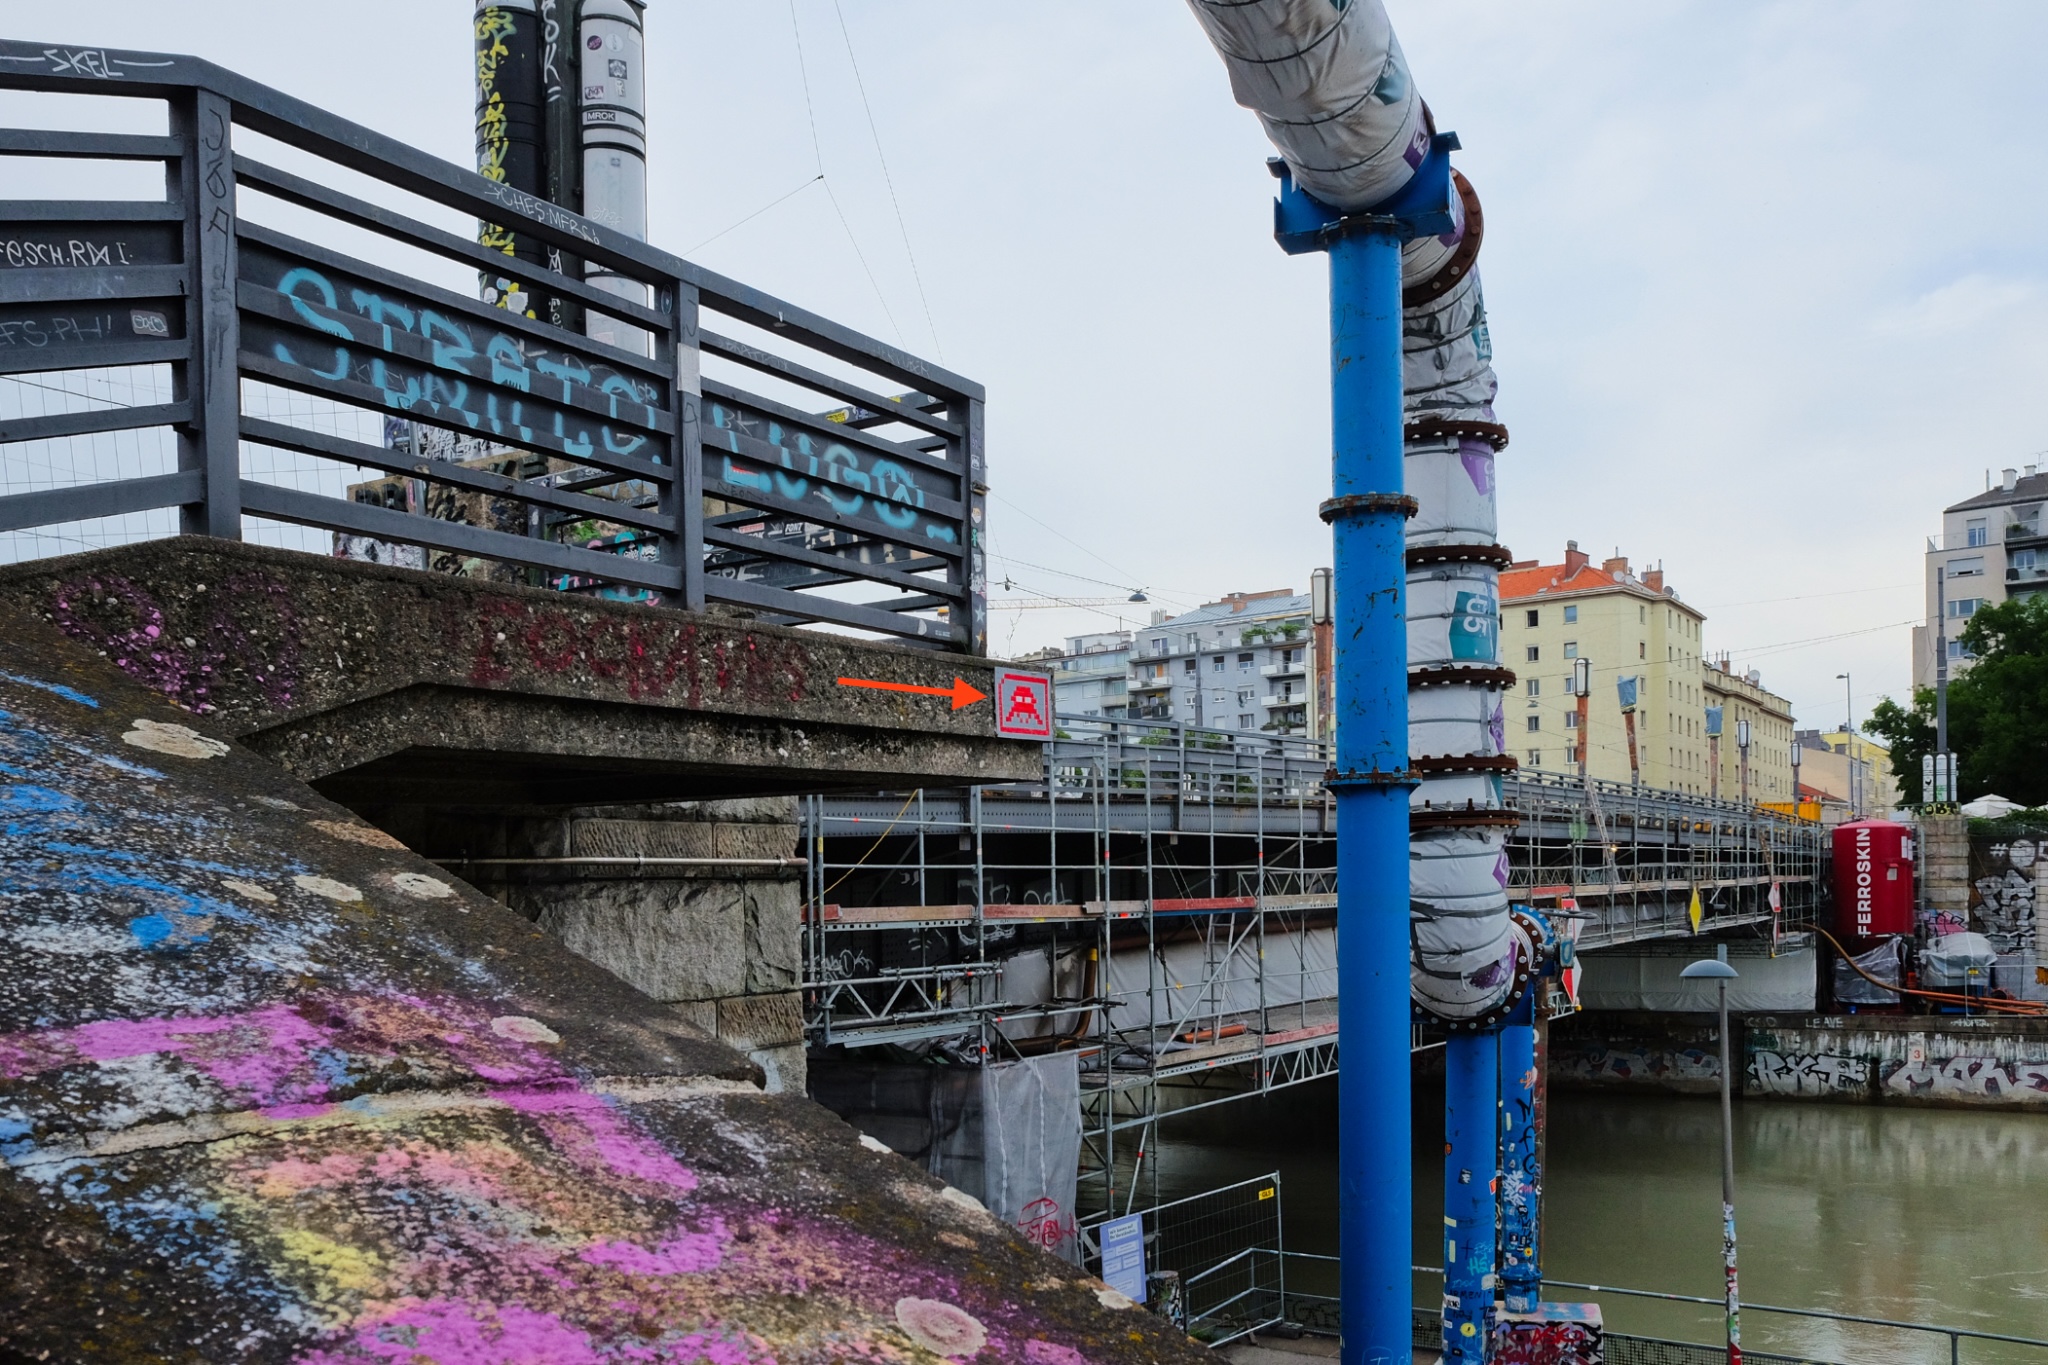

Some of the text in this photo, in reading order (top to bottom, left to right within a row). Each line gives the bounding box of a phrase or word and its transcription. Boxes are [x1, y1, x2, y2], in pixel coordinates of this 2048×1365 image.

[587, 112, 615, 120] MROK
[1856, 828, 1872, 936] FERROSKIN
[1913, 1049, 1921, 1059] 3
